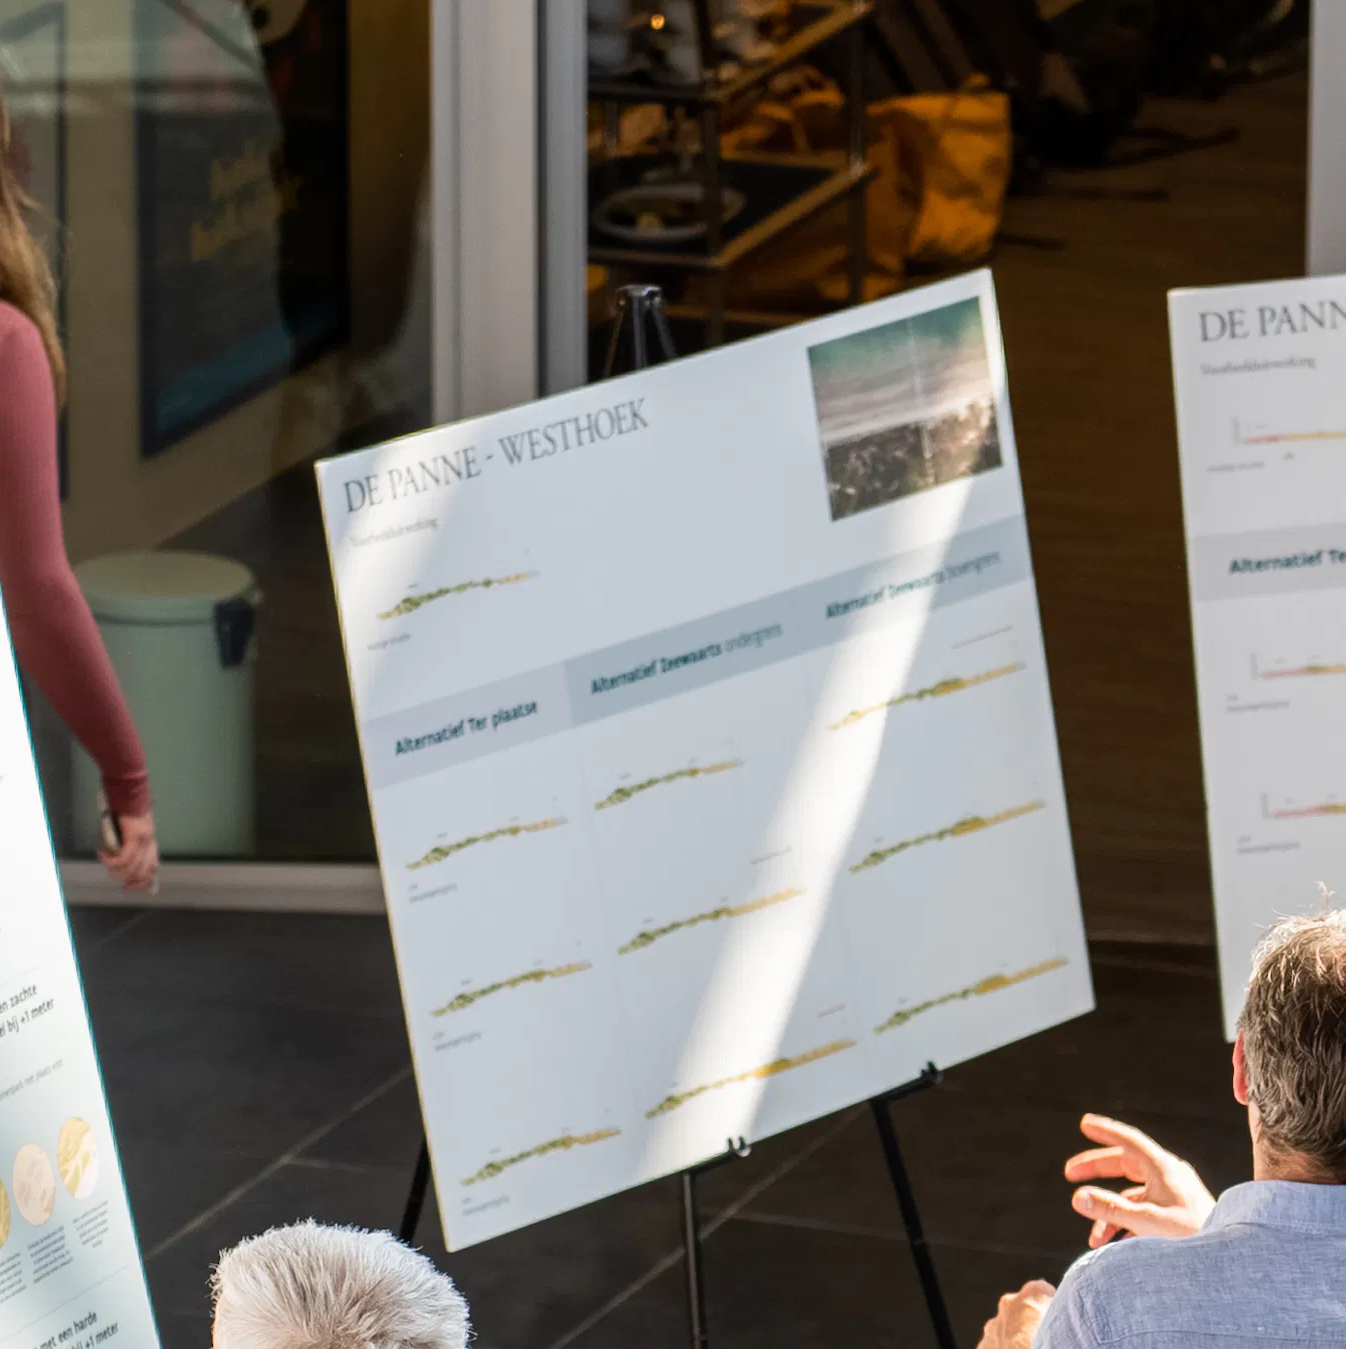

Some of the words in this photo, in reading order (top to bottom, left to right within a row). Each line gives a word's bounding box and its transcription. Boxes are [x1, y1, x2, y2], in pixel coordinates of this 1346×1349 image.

[1198, 308, 1250, 343] DE
[344, 470, 384, 513] DE
[387, 441, 482, 505] PANNE
[499, 399, 650, 469] WESTHOEK
[1229, 549, 1325, 575] Alternatief
[591, 657, 657, 696] Alternatief
[659, 640, 724, 678] Zeewaarts
[395, 717, 466, 757] Alternatief
[468, 712, 489, 733] Ter
[491, 698, 539, 734] plaatse
[9, 984, 37, 1008] zachte
[6, 1015, 20, 1032] bij
[30, 998, 55, 1019] meter
[57, 1326, 73, 1343] een
[72, 1310, 98, 1333] harde
[95, 1321, 119, 1344] meter
